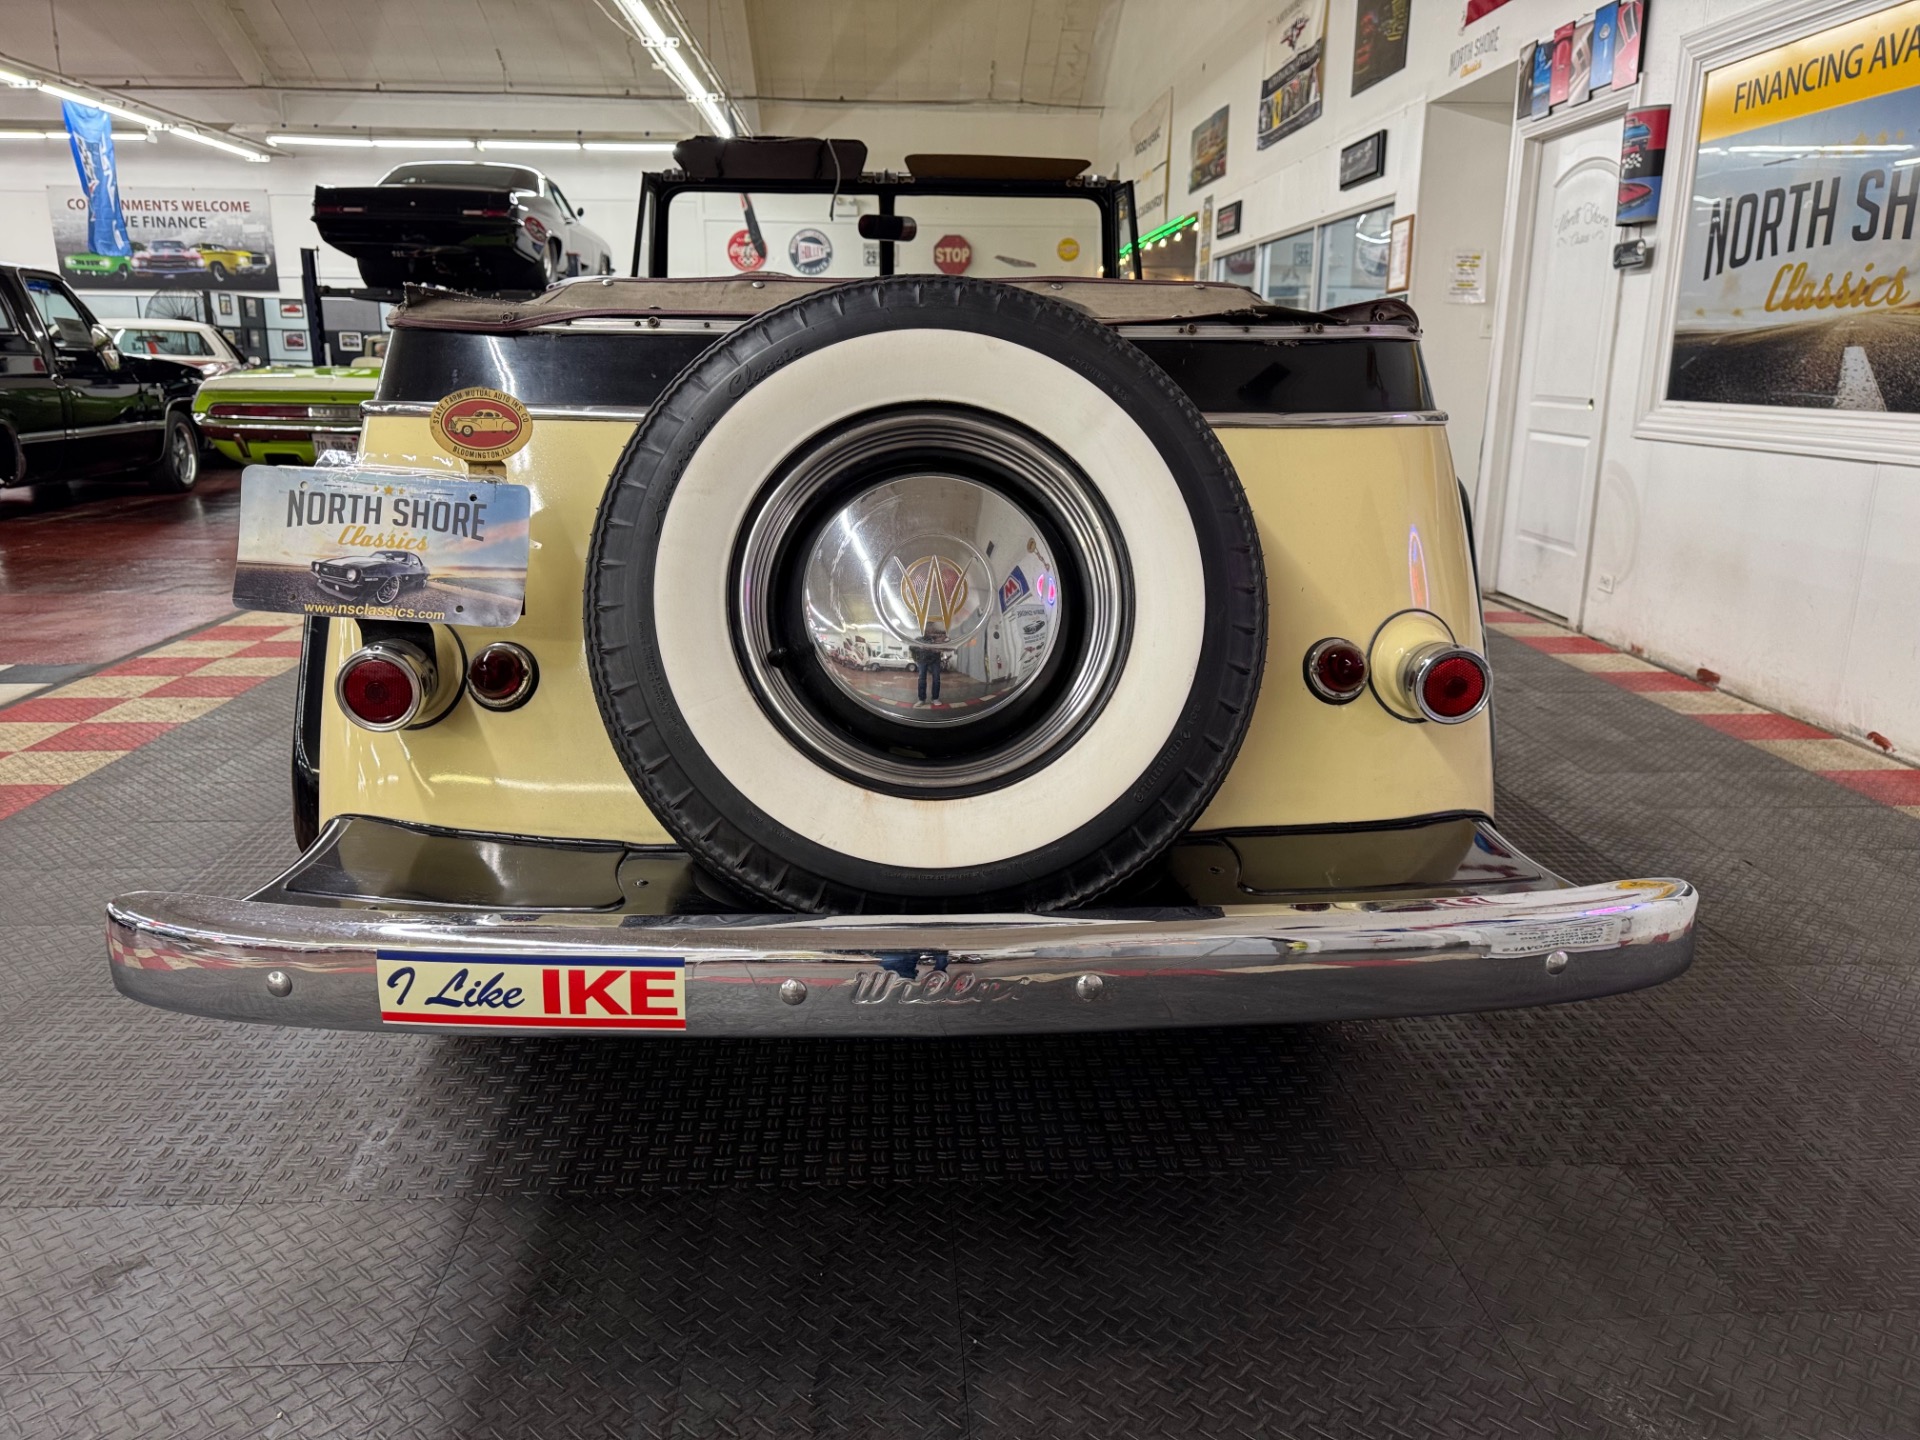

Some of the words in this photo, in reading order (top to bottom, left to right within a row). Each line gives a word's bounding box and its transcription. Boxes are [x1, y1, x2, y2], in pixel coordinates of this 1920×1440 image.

[1734, 43, 1864, 114] FINANCING
[67, 198, 178, 212] CONMENTS
[182, 200, 251, 212] WELCOME
[143, 216, 207, 228] FINANCE
[1703, 176, 1841, 281] NORTH
[935, 247, 970, 263] STOP
[1764, 262, 1911, 313] Classics
[728, 345, 803, 399] Classic
[433, 403, 446, 425] STATE
[445, 392, 463, 405] FARM
[465, 389, 492, 398] MUTUAL
[493, 392, 511, 403] AUTO
[286, 489, 383, 528] NORTH
[392, 498, 488, 542] SHORE
[337, 525, 429, 551] Classics
[304, 602, 446, 620] www.nsclassics.com
[386, 966, 416, 1006] I
[424, 967, 525, 1009] Like
[542, 968, 679, 1016] IKE
